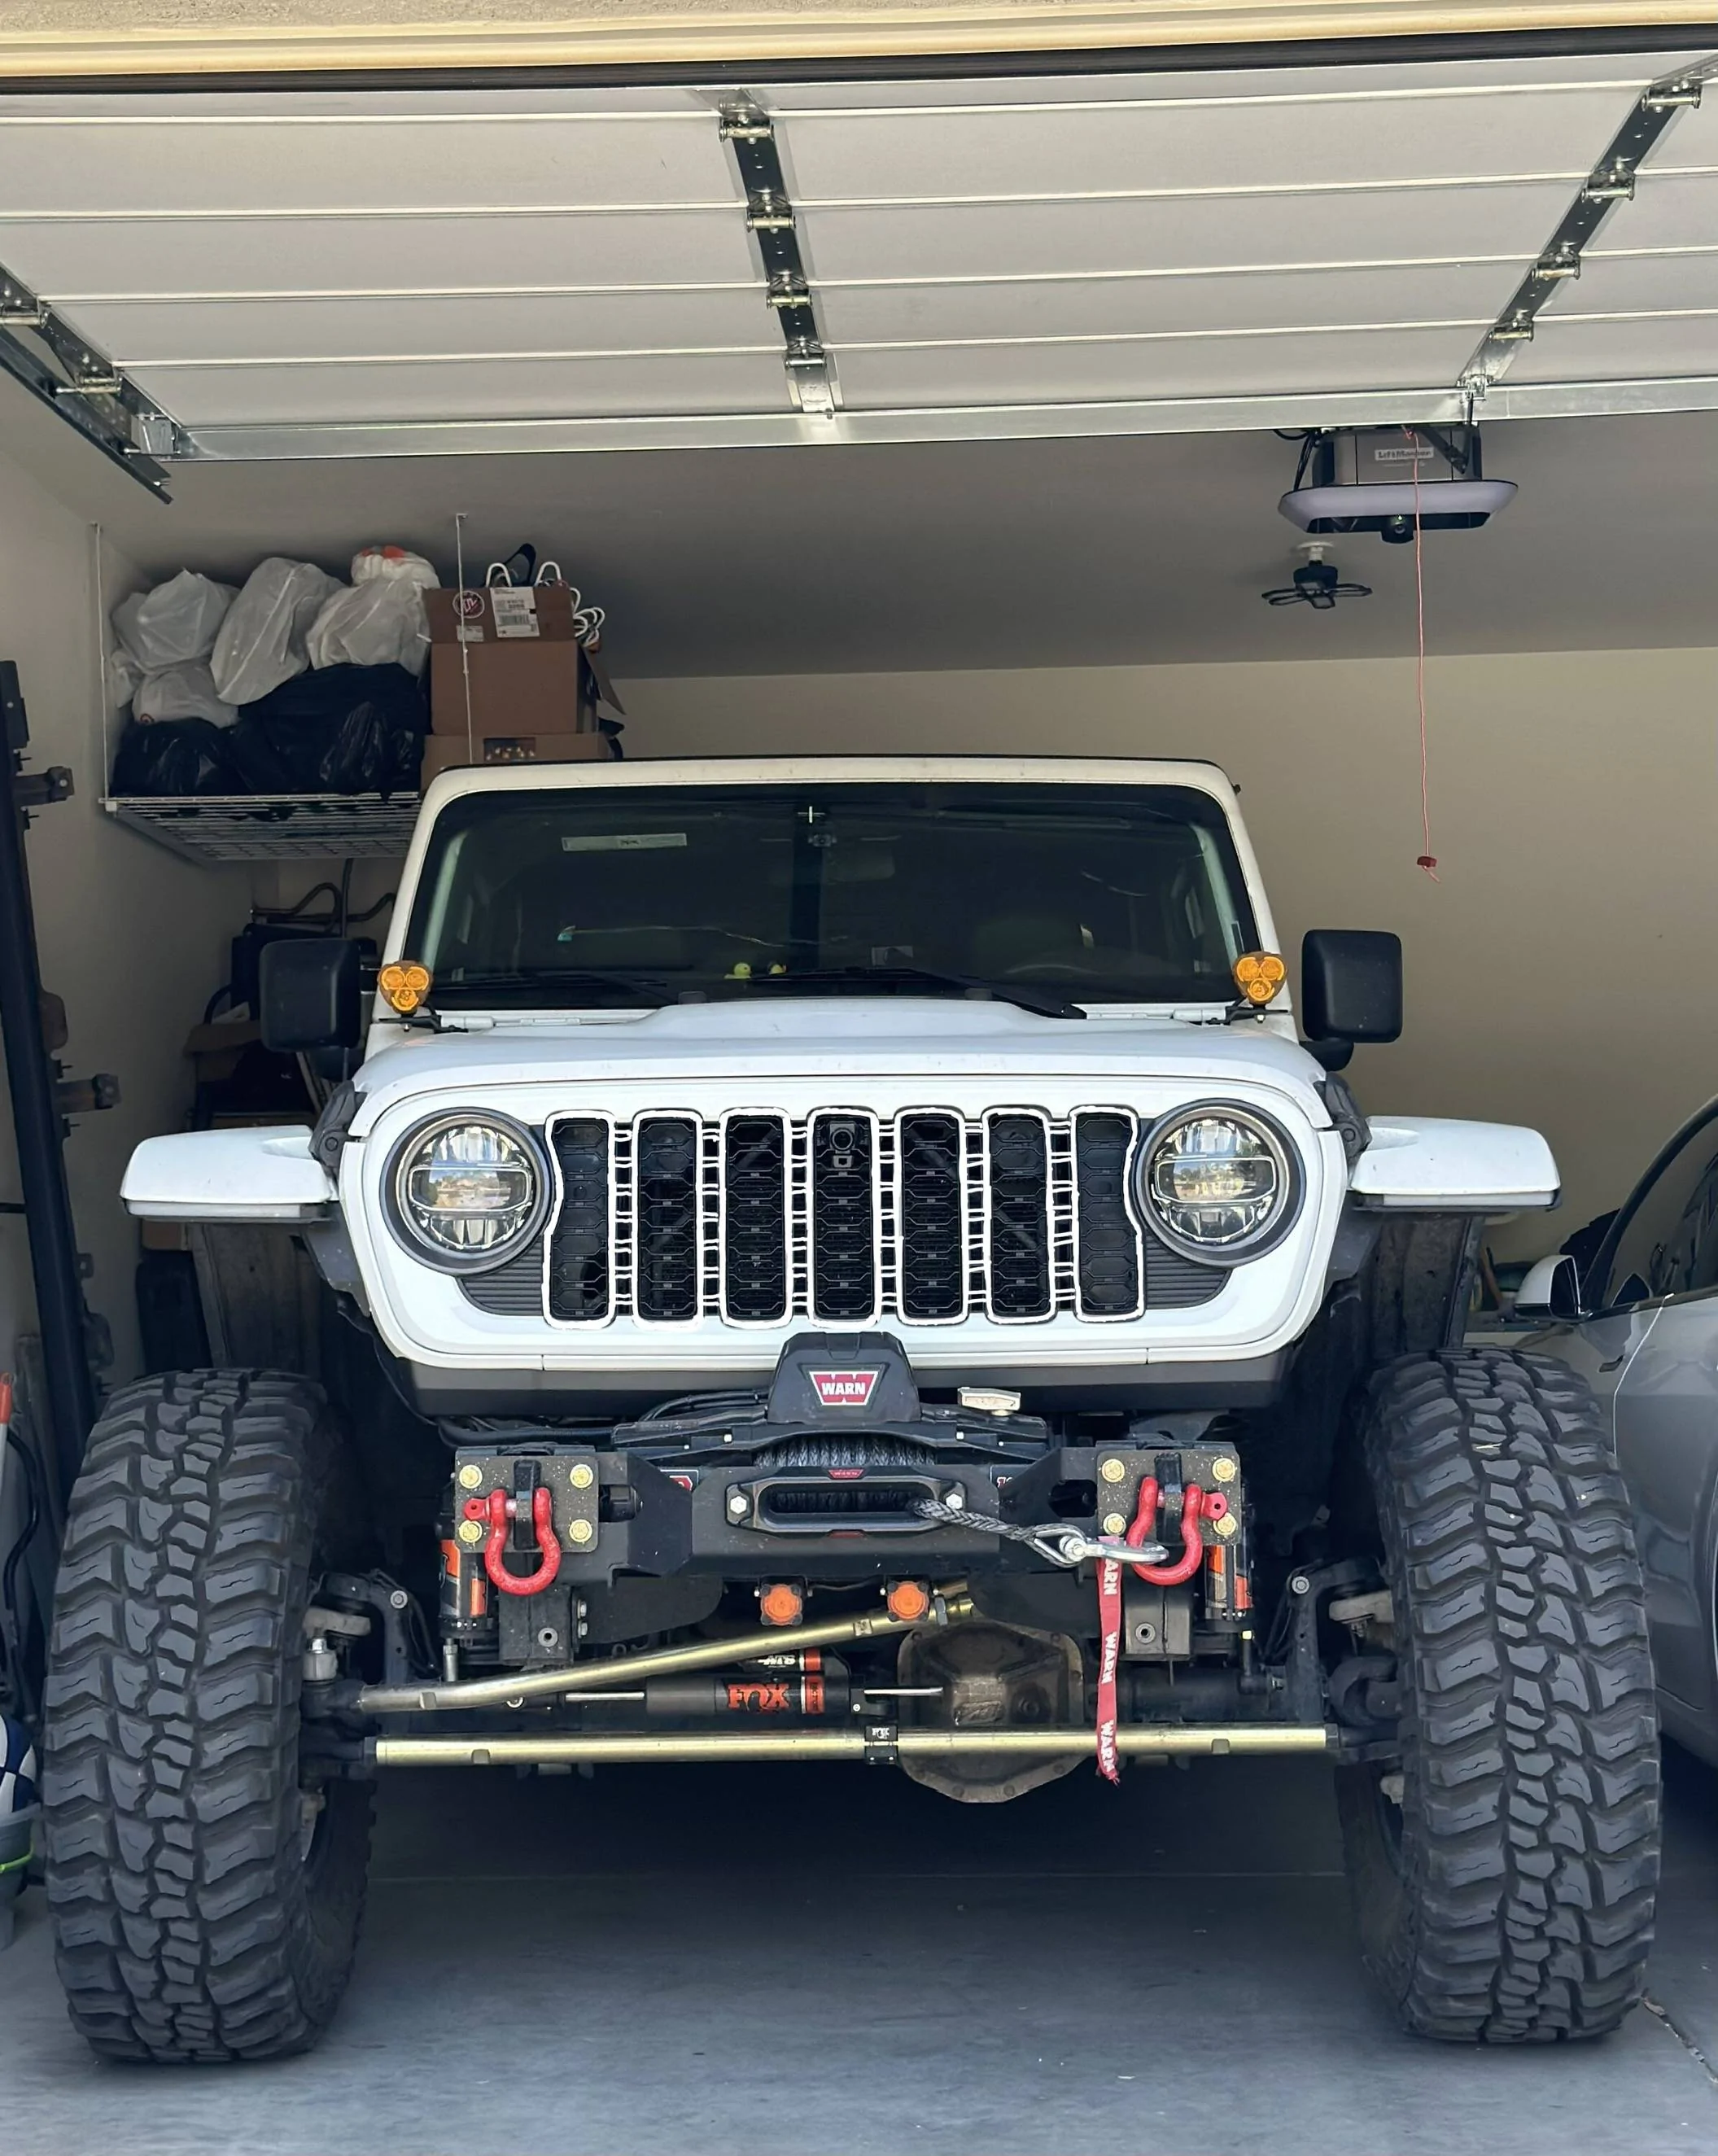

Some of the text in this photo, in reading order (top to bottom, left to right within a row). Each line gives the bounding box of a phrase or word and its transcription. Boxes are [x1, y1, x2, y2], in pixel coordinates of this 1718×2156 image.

[821, 1382, 866, 1396] WARN
[1104, 1558, 1120, 1595] ARN
[1101, 1631, 1118, 1684] WARN
[728, 1682, 791, 1712] FOX
[1100, 1720, 1116, 1773] WARN
